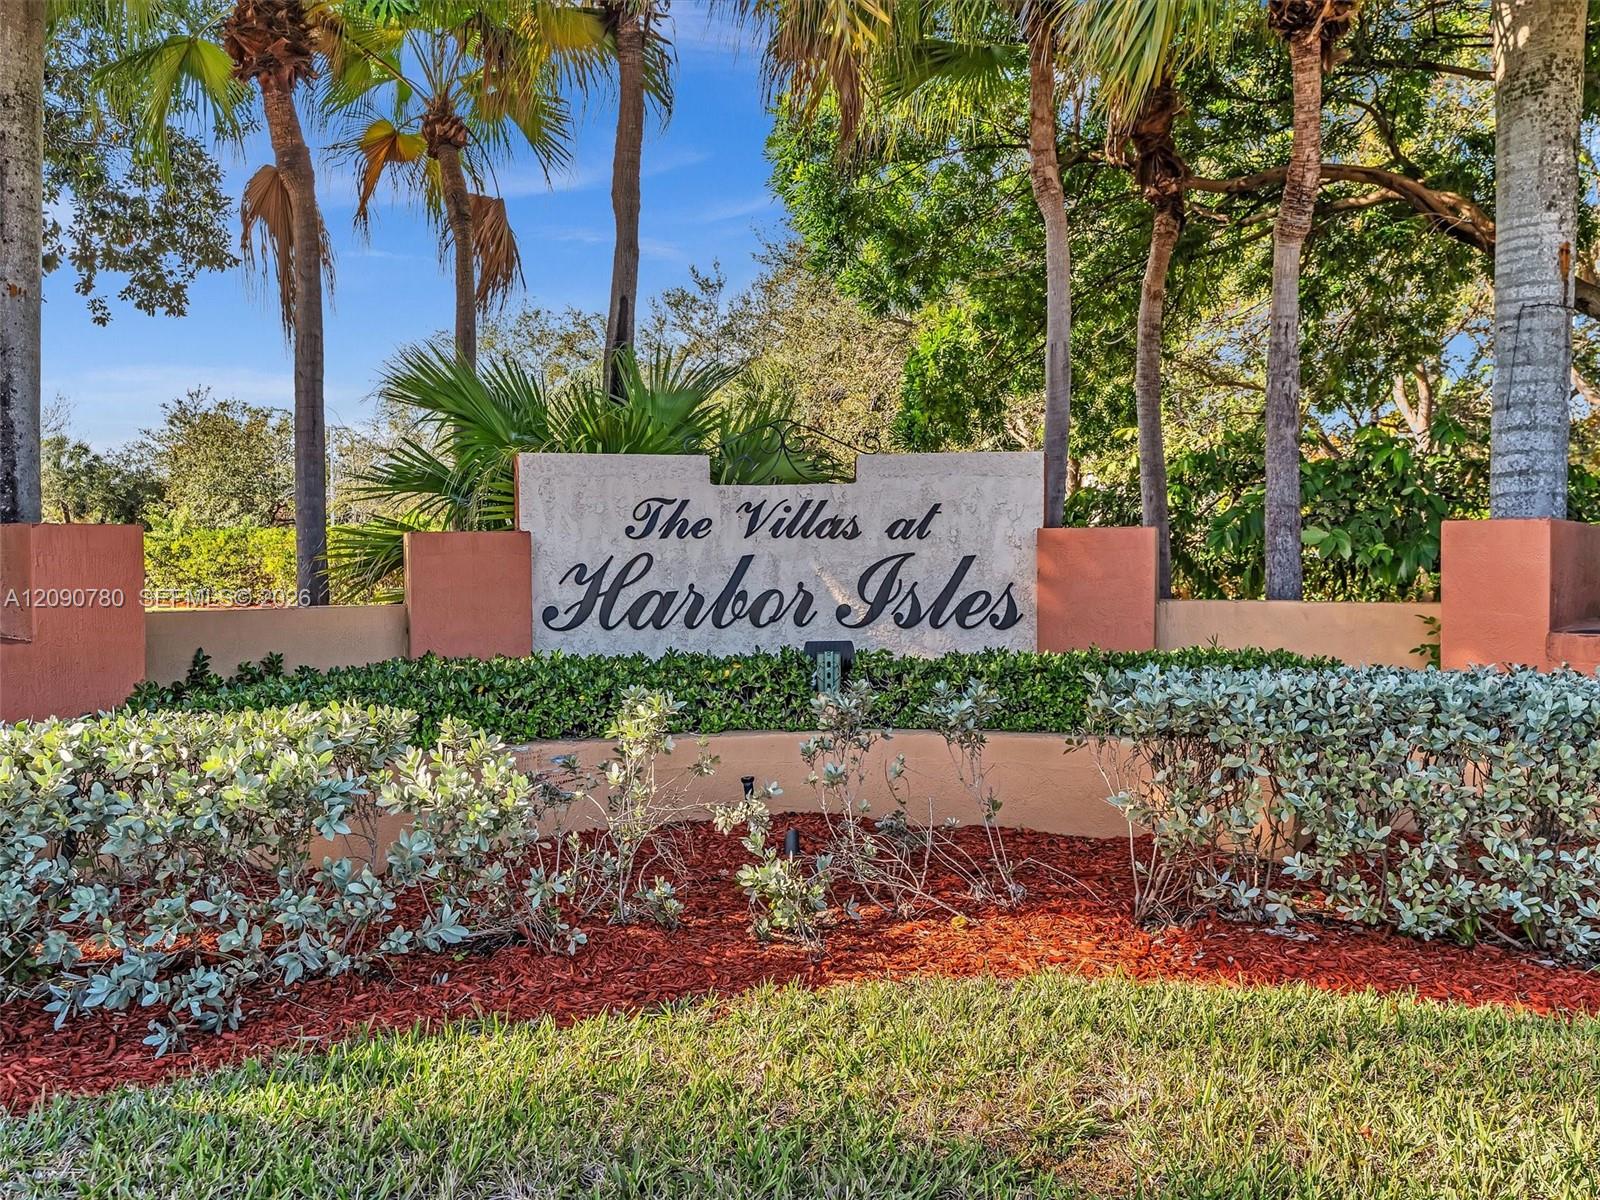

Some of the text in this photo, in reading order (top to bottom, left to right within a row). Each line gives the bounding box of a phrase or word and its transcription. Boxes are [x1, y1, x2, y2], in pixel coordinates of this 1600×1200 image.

[625, 497, 943, 540] The Villas at
[542, 552, 1024, 631] Harbor Isles
